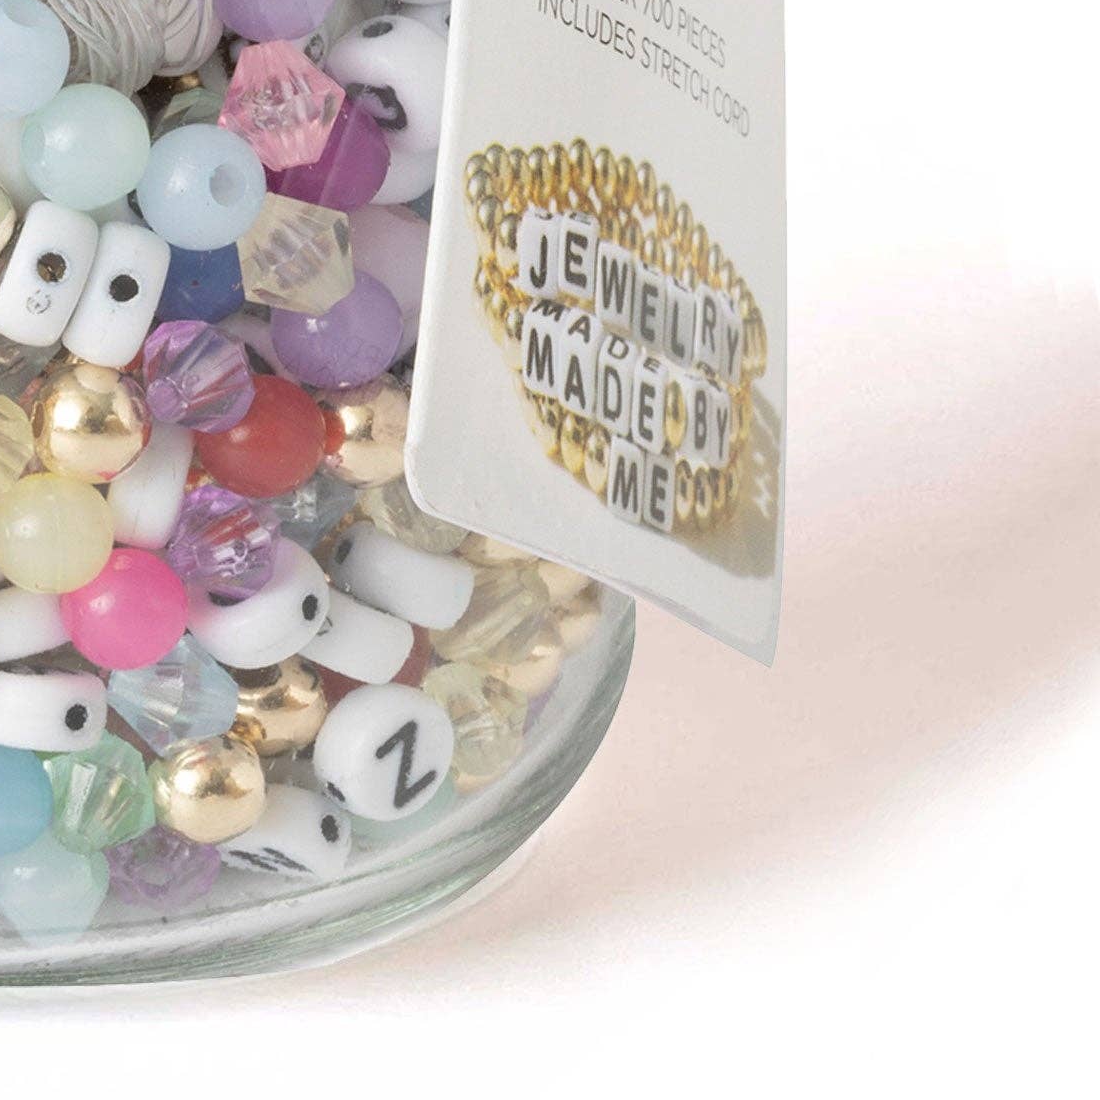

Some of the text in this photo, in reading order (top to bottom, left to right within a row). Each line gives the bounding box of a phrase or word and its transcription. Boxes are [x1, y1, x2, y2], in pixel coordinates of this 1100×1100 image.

[677, 4, 727, 69] PIECES
[641, 37, 710, 109] STRETCH
[713, 86, 751, 139] CORD
[530, 233, 739, 375] JEWELRY
[526, 327, 729, 459] MADE BY
[611, 455, 671, 525] ME
